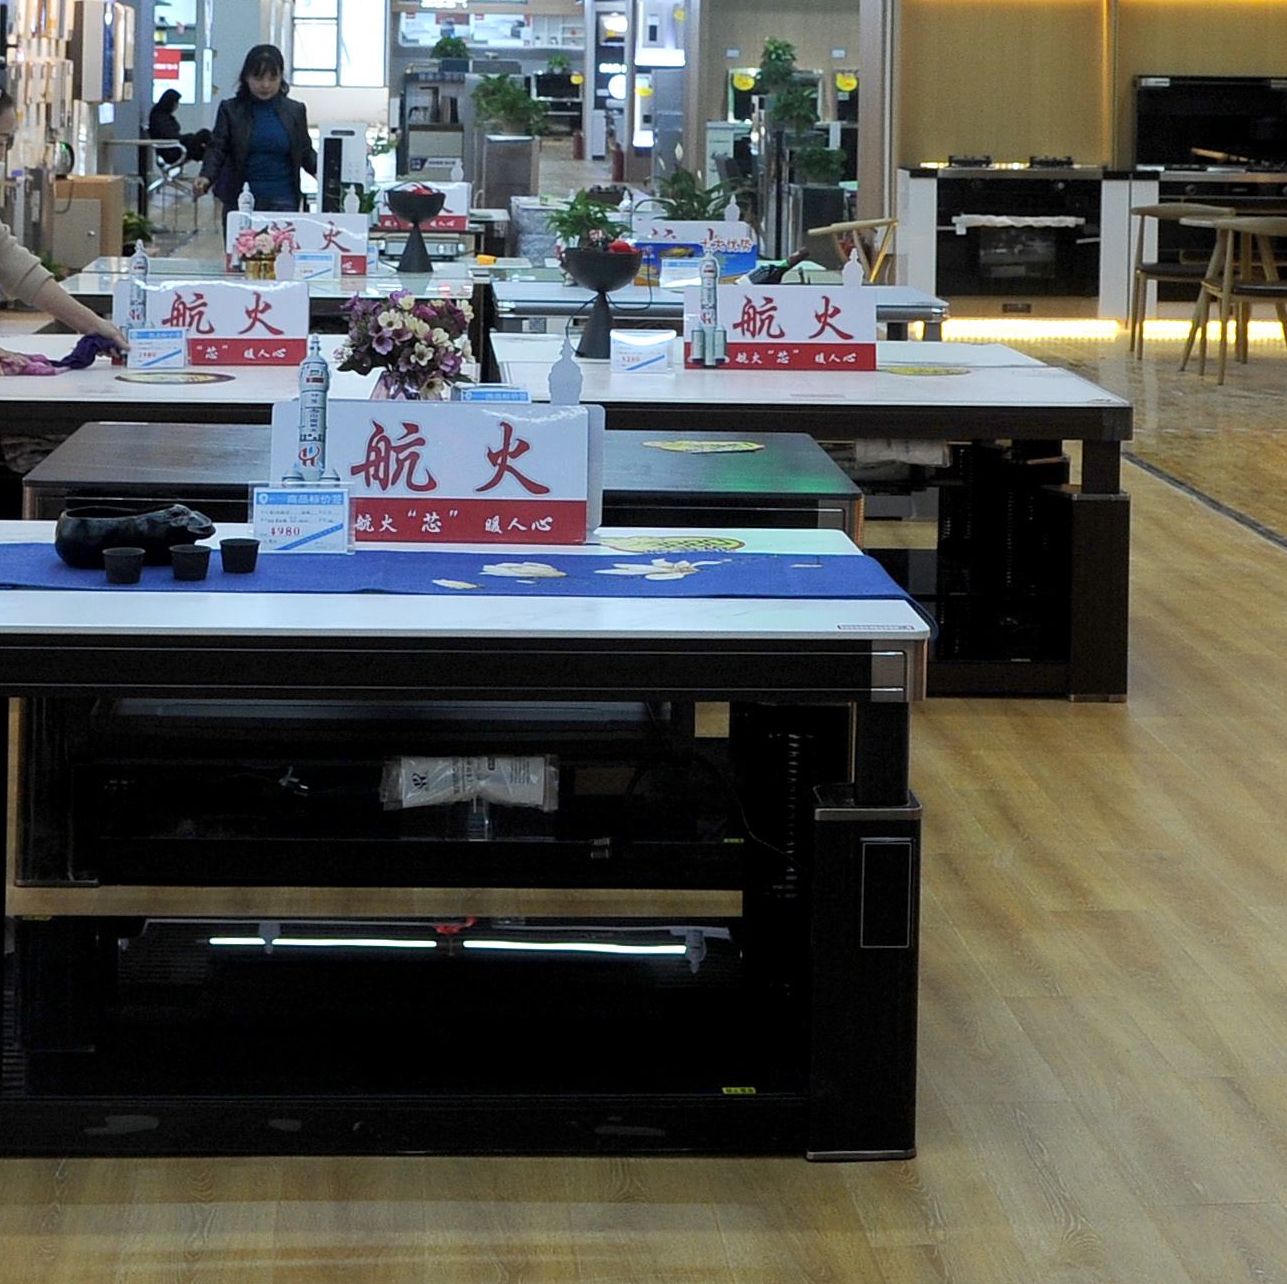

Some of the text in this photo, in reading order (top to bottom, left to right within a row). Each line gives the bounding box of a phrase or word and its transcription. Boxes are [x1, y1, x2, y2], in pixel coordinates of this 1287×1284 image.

[162, 290, 285, 335] 航火
[732, 295, 855, 340] 航火
[814, 352, 857, 364] 暖人心
[350, 419, 552, 496] 航火
[484, 514, 555, 534] 暖人心
